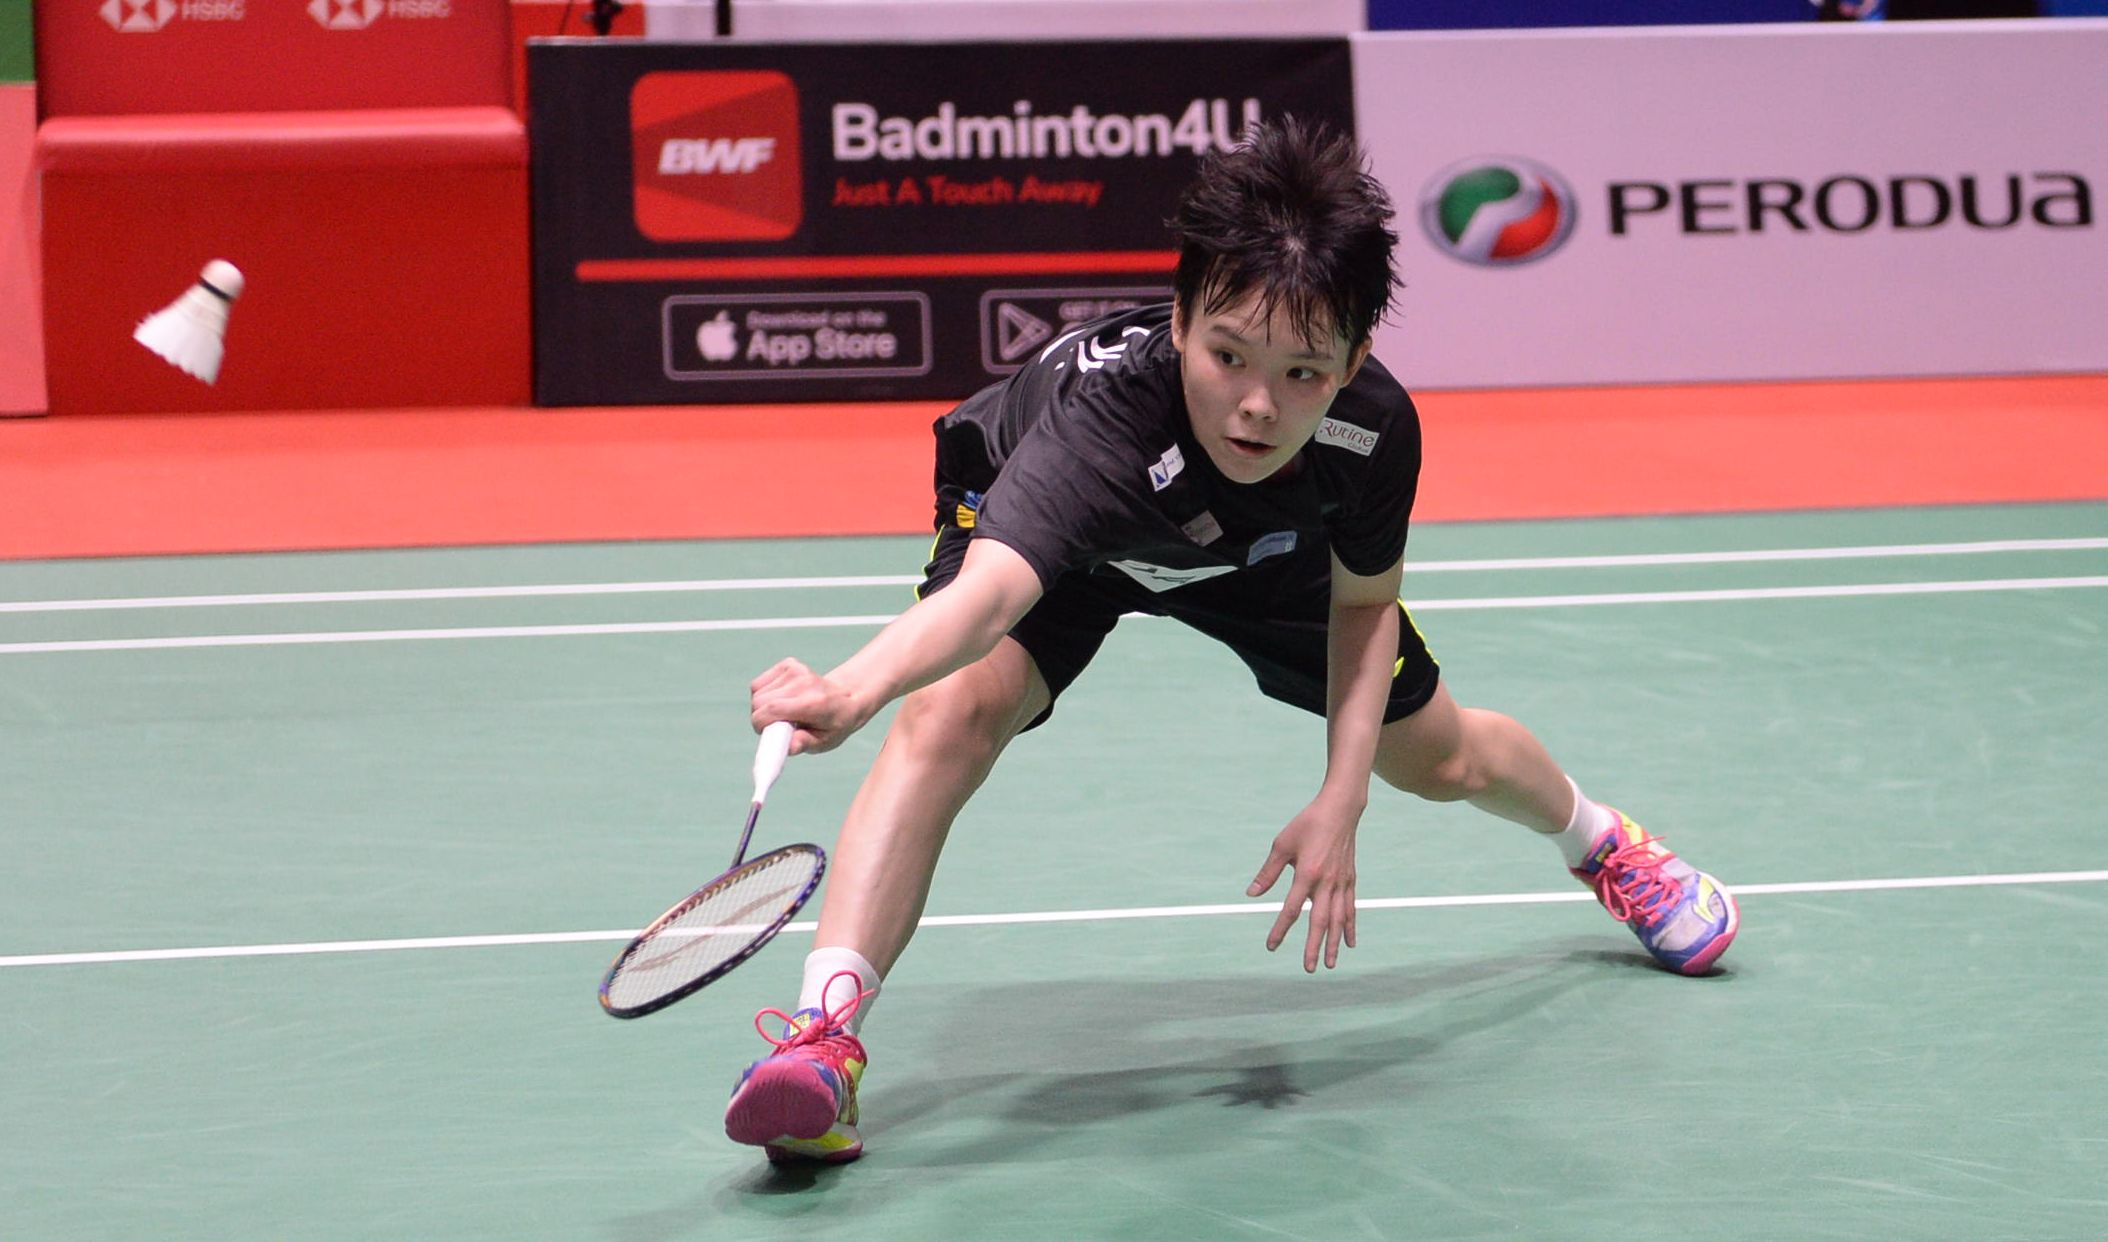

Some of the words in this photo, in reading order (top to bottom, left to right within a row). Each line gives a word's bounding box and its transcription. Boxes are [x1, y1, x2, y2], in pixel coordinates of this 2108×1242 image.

[181, 0, 245, 20] HSBC
[832, 99, 1261, 160] Badminton4U
[659, 137, 776, 175] BWF
[833, 177, 891, 206] Just
[896, 176, 922, 204] A
[927, 174, 1015, 205] Touch
[1018, 174, 1103, 207] Away
[746, 310, 829, 329] Download
[746, 329, 812, 365] App
[814, 327, 897, 359] Store
